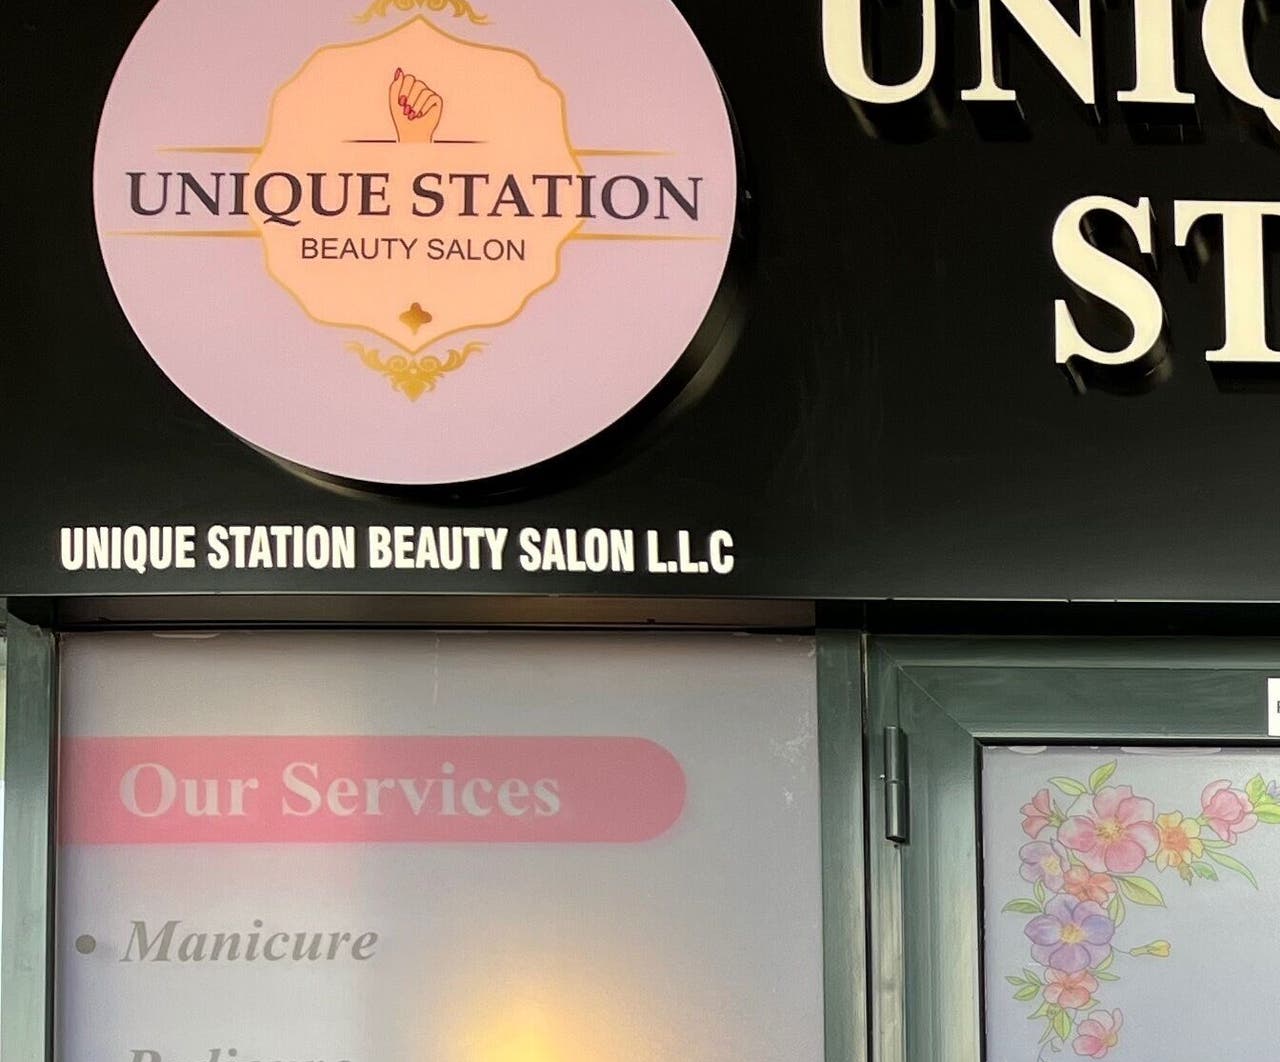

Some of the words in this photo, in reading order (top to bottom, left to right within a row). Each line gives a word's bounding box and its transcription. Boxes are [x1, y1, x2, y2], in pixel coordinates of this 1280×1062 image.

[125, 172, 391, 227] UNIQUE
[411, 173, 703, 222] STATION
[301, 238, 418, 261] BEAUTY
[426, 238, 526, 262] SALON
[60, 525, 196, 571] UNIQUE
[207, 525, 355, 570] STATION
[369, 525, 508, 571] BEAUTY
[520, 527, 635, 573] SALON
[648, 529, 735, 574] L.L.C
[120, 762, 258, 818] Our
[281, 761, 561, 817] Services
[120, 919, 380, 963] Manicure
